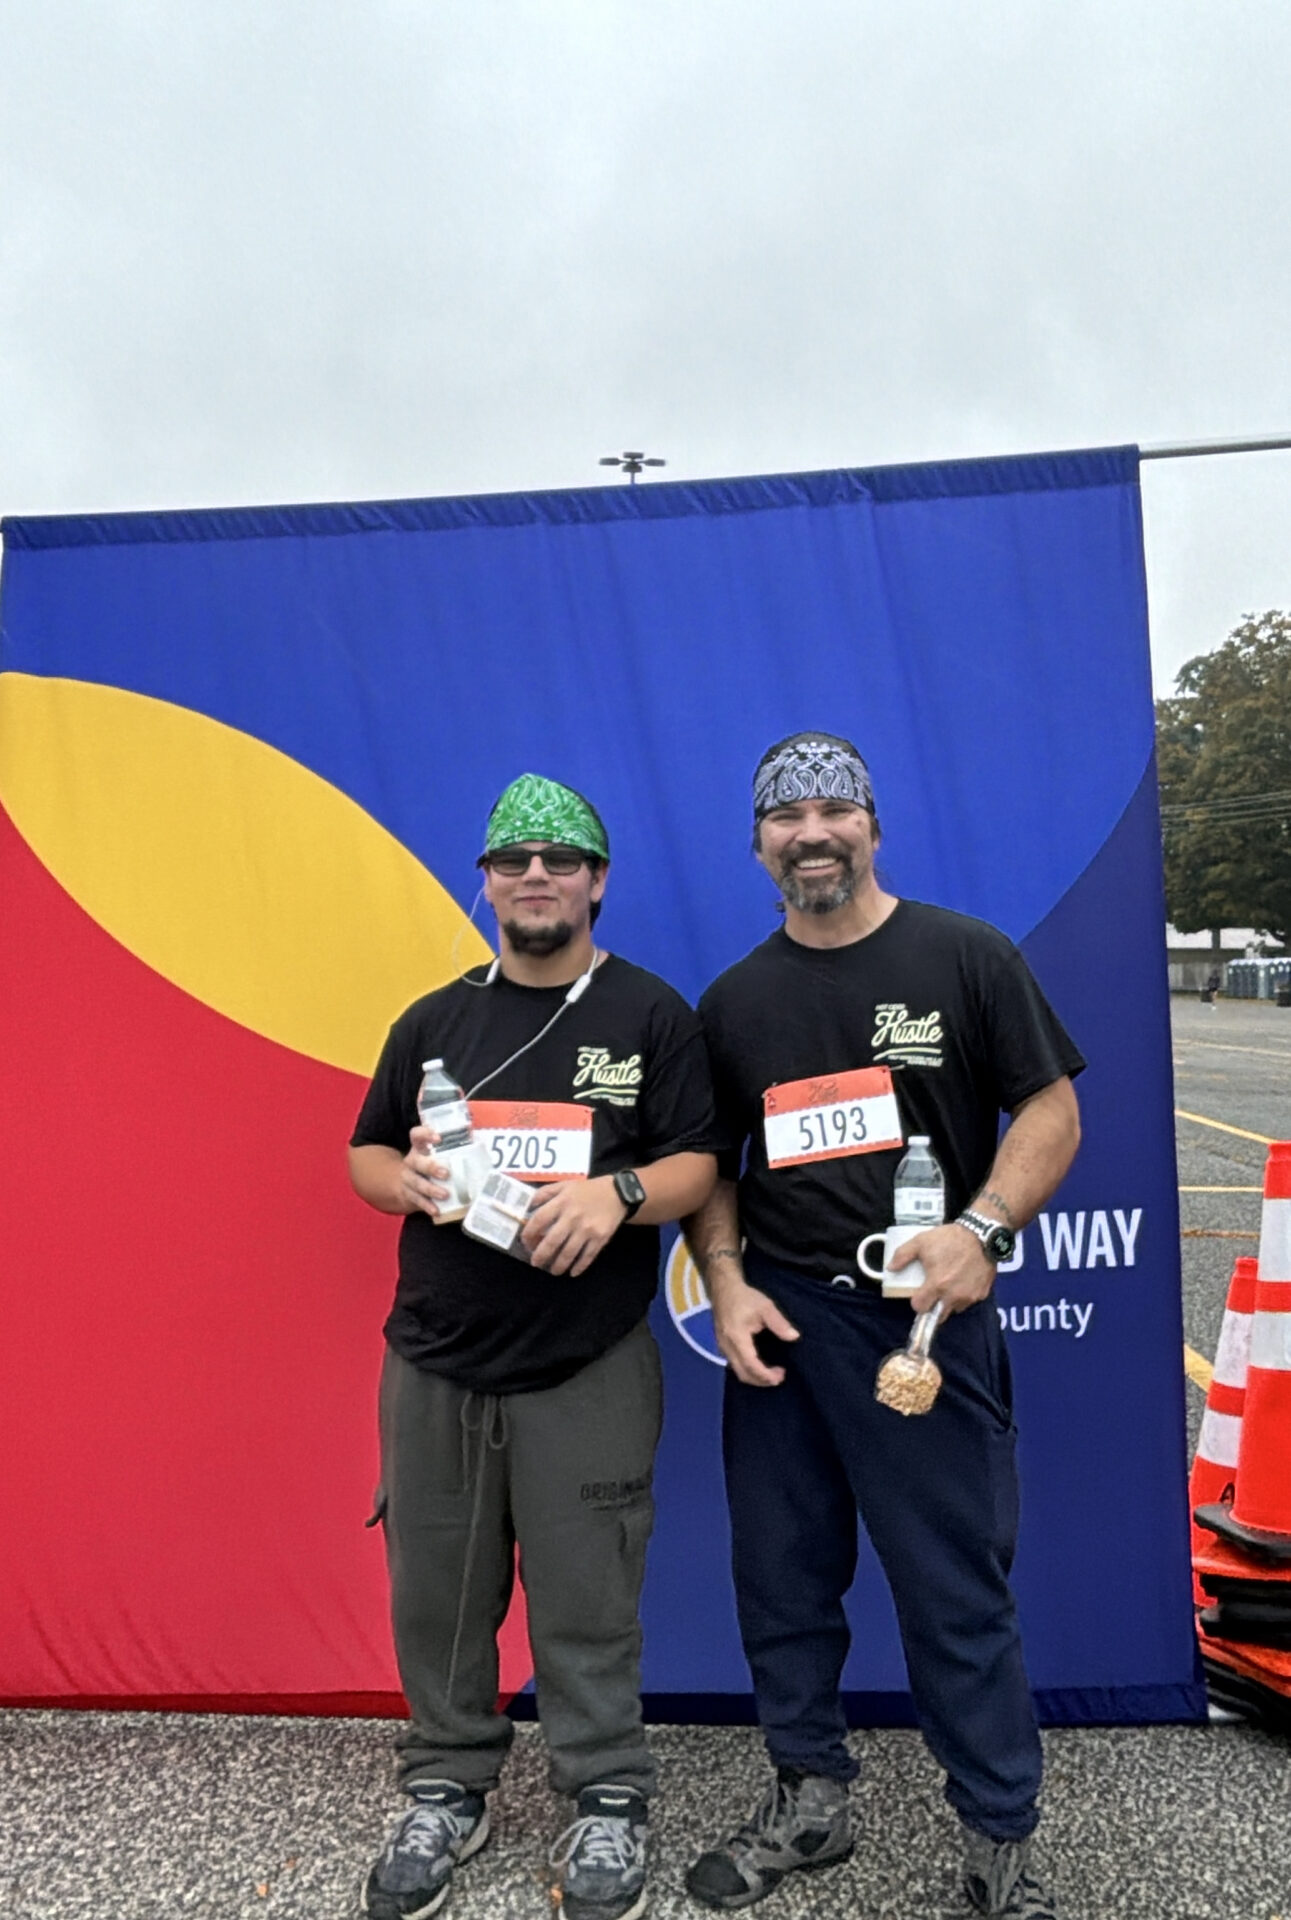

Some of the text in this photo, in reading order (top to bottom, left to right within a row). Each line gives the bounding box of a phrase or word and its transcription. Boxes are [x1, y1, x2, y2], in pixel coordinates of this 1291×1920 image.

[871, 1009, 944, 1048] Hustle
[572, 1053, 643, 1087] Hustle
[799, 1106, 867, 1151] 5193
[491, 1135, 558, 1169] 5205
[1038, 1208, 1143, 1271] WAY
